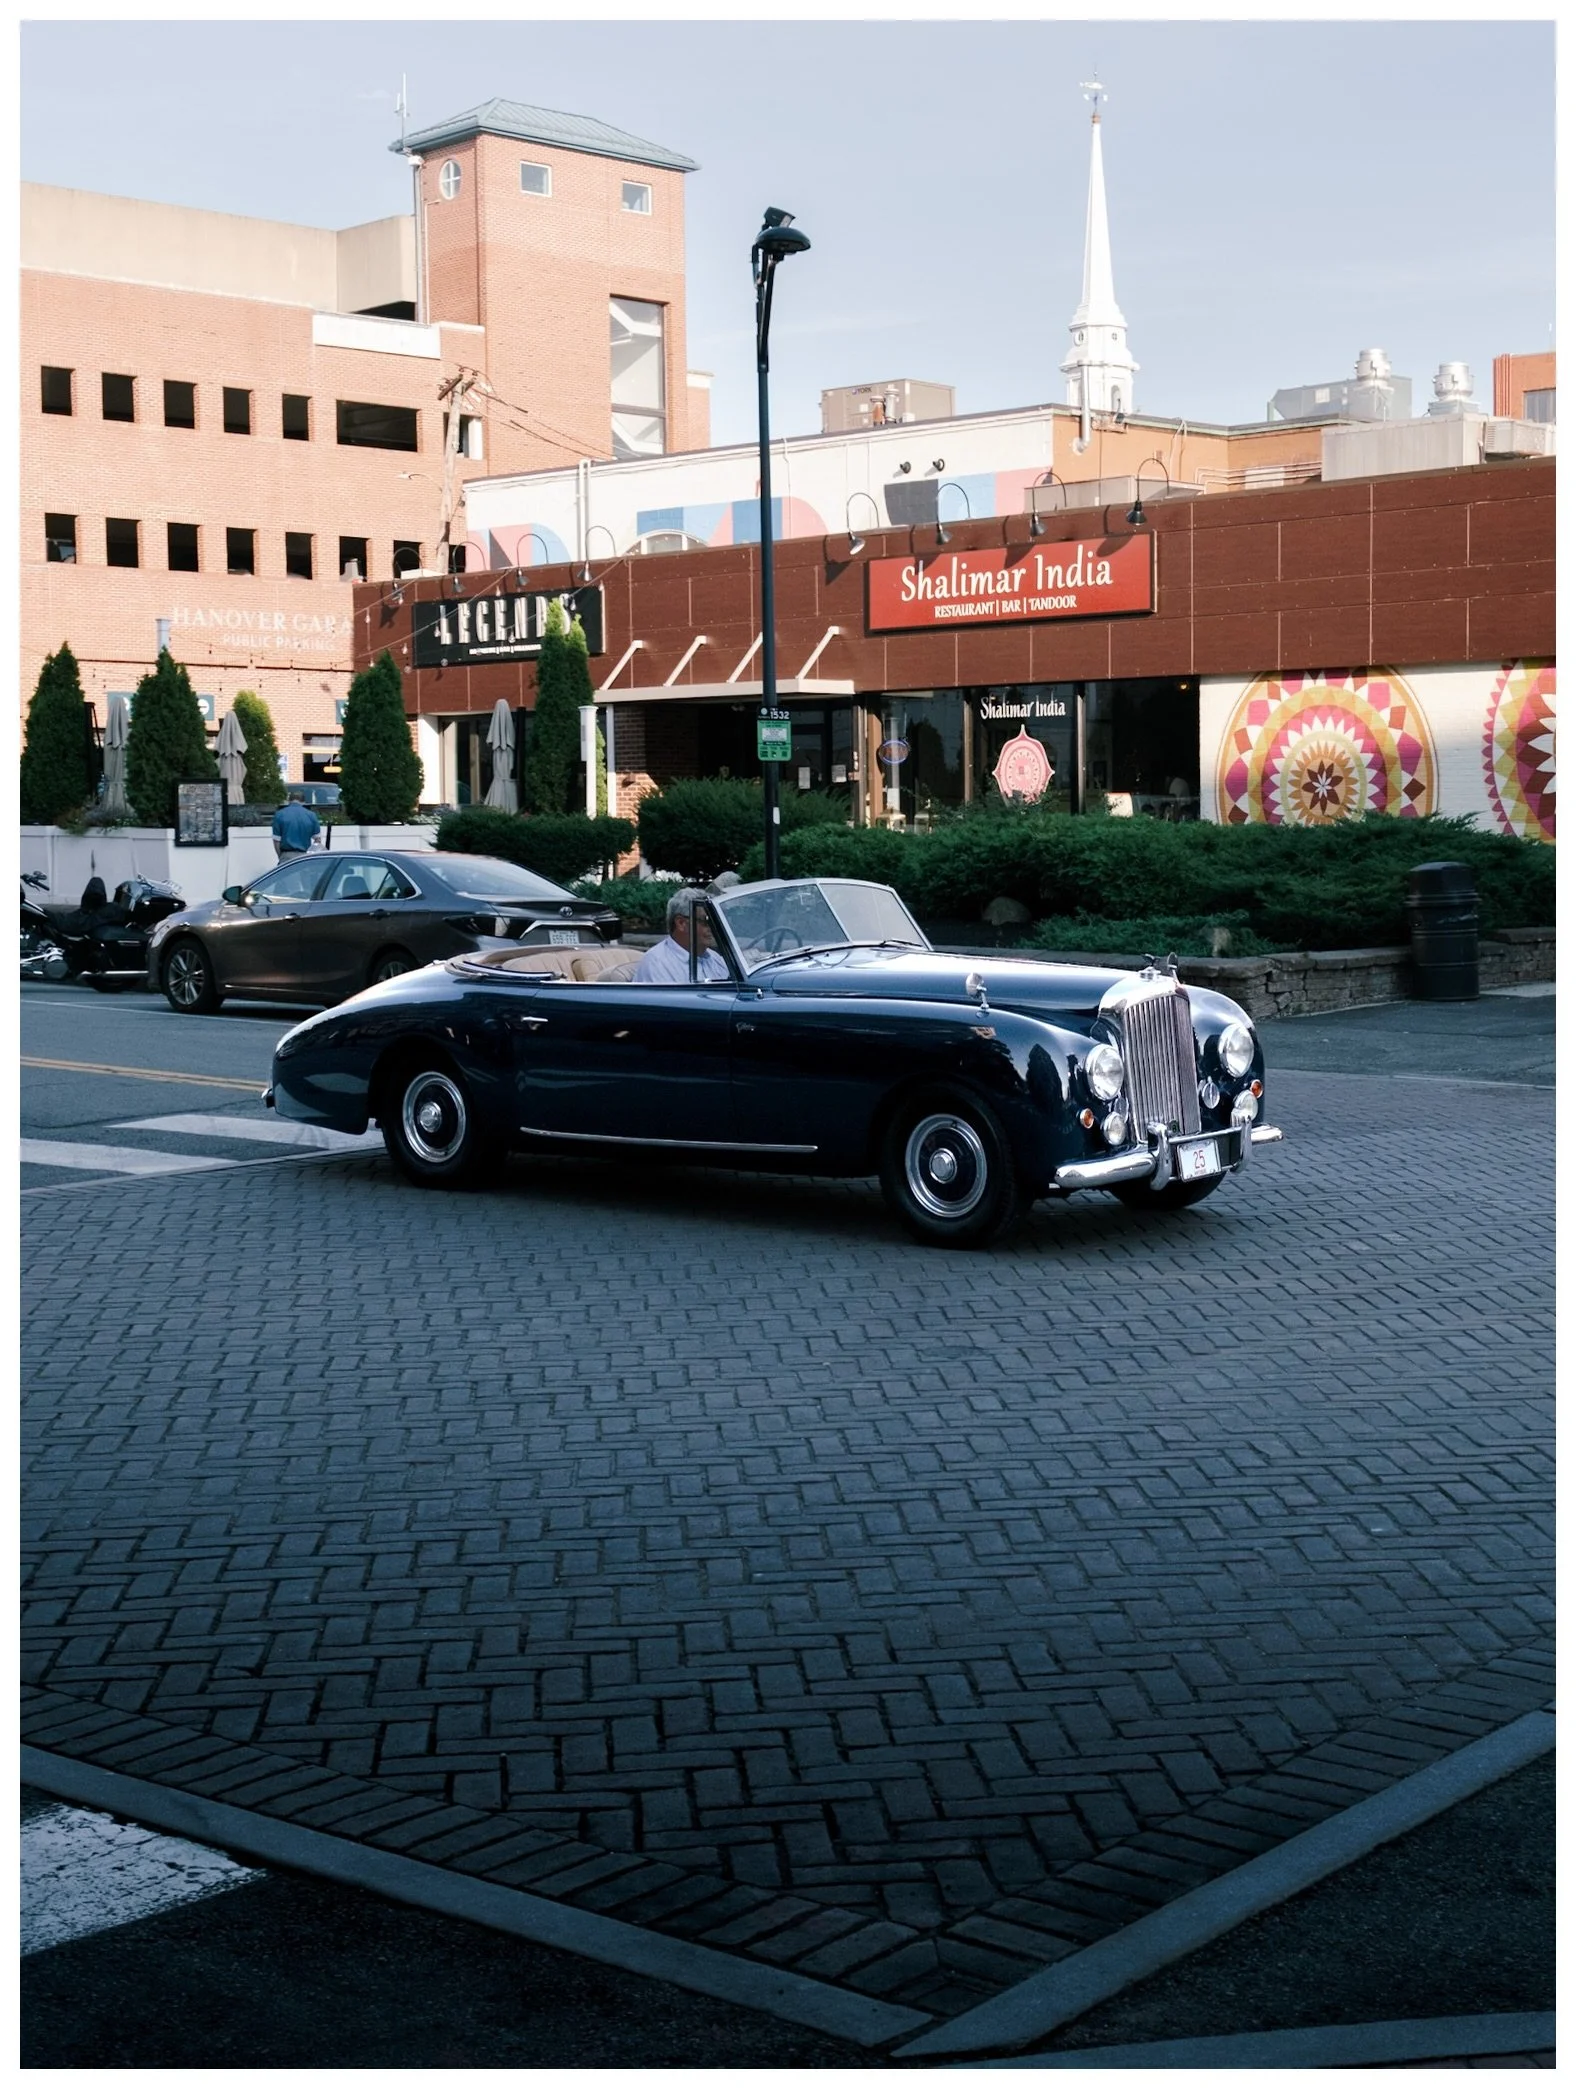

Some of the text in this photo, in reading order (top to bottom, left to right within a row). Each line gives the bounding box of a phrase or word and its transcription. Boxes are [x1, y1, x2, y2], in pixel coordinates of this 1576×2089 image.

[901, 544, 1113, 602] Shalimar India
[934, 595, 1077, 618] RESTAURANT BAR TANDOOR
[172, 607, 286, 630] HANOVER
[223, 634, 334, 650] PUBLIC PARKING
[770, 711, 790, 719] 1532
[980, 690, 1066, 719] Shalimar India
[1193, 1150, 1206, 1169] 25
